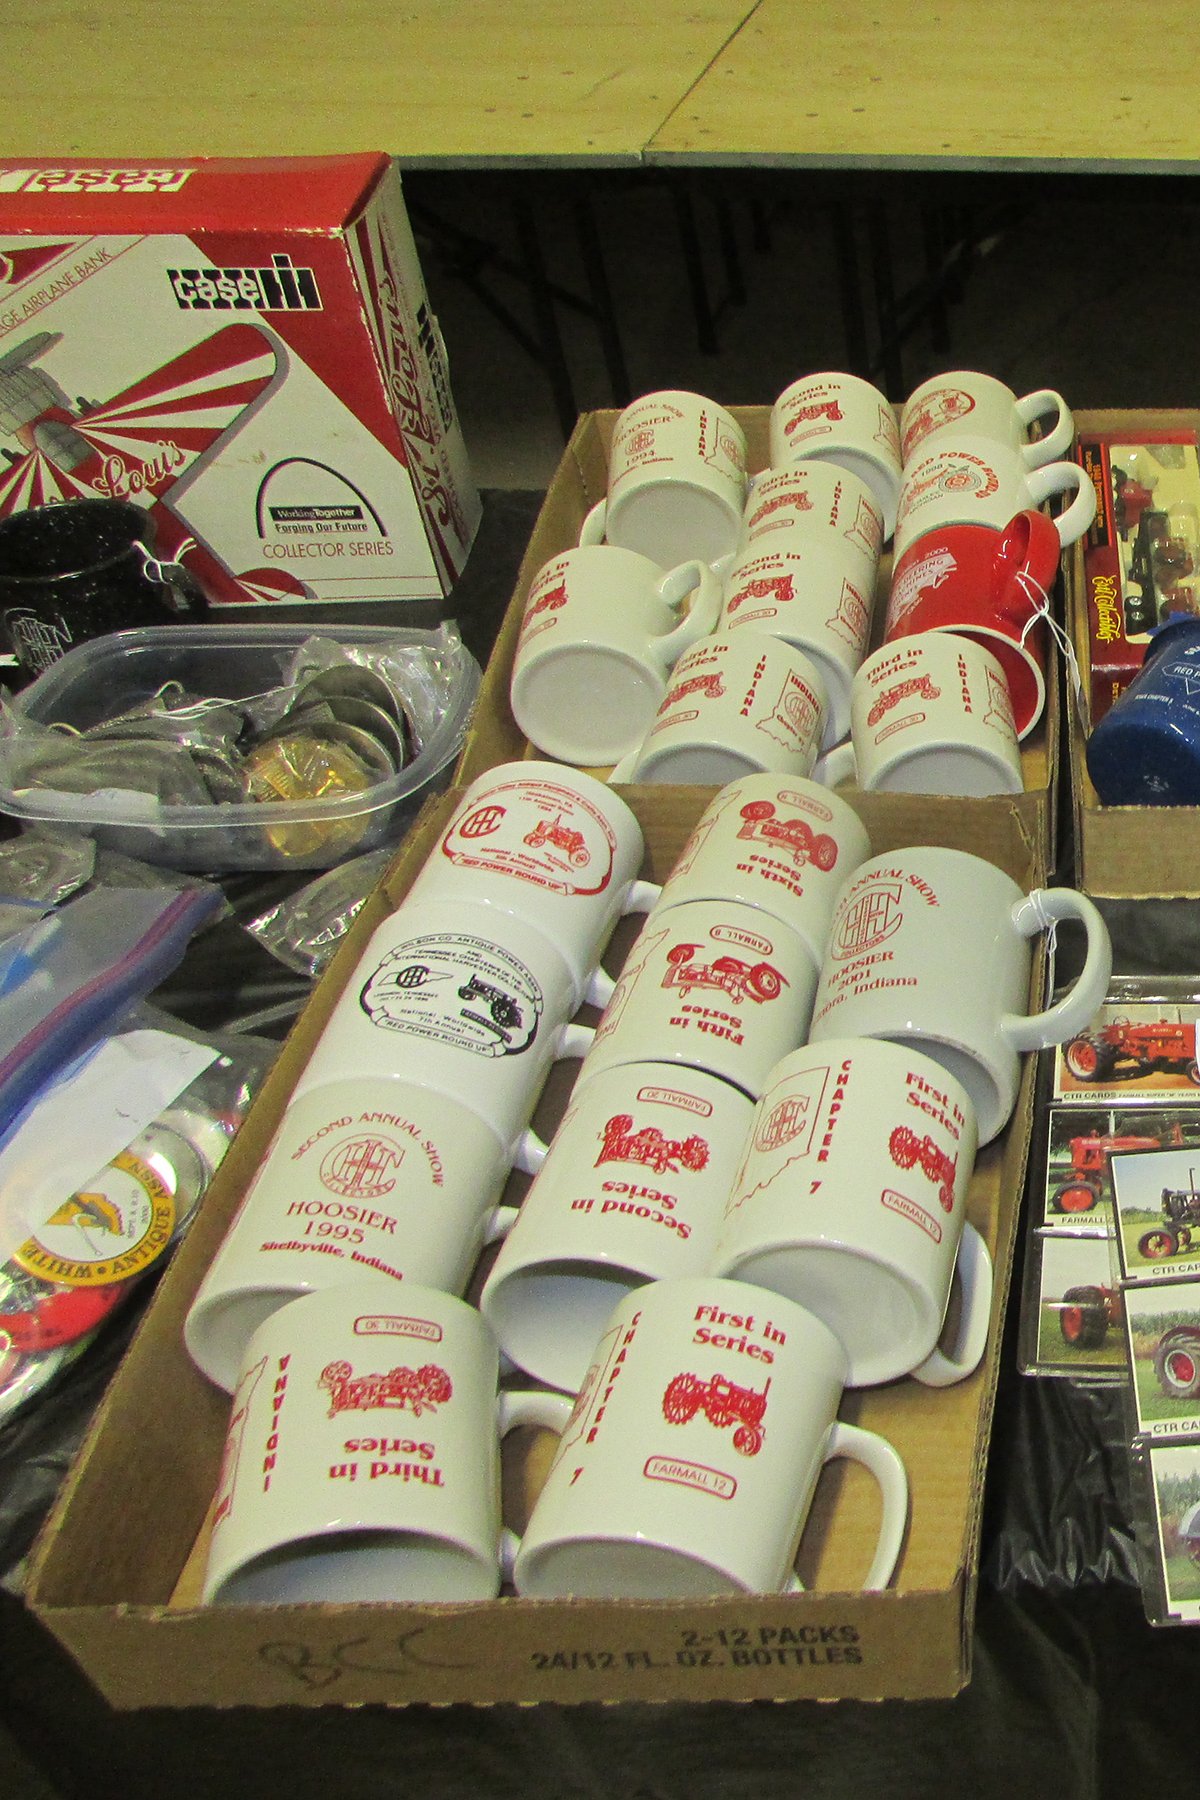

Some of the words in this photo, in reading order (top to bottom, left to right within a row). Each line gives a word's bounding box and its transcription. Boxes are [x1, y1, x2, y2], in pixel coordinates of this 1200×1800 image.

[22, 271, 78, 316] AIRPLANE
[76, 247, 115, 279] BANK
[698, 409, 708, 457] INDIANA
[92, 440, 187, 501] Louis
[939, 451, 986, 466] POWER
[828, 480, 843, 527] INDIANA
[315, 521, 334, 533] Our
[334, 521, 368, 533] Future
[262, 543, 347, 560] COLLECTOR
[349, 541, 394, 558] SERIES
[786, 551, 801, 560] in
[712, 644, 729, 653] in
[866, 653, 902, 681] Third
[907, 648, 924, 658] in
[1174, 666, 1194, 676] RED
[740, 654, 767, 717] INDIANA
[957, 653, 973, 714] INDIANA
[480, 861, 514, 874] POWER
[515, 870, 547, 886] ROUND
[736, 862, 755, 875] in
[749, 854, 802, 882] Series
[905, 873, 941, 908] SHOW
[415, 949, 457, 957] TENNESSEE
[457, 936, 496, 951] ANTIQUE
[728, 929, 770, 953] FARMALL
[453, 959, 497, 978] HARVESTER
[837, 968, 872, 993] 2001
[854, 976, 918, 997] Indiana
[435, 1020, 466, 1034] Annual
[669, 1016, 691, 1029] in
[681, 1004, 743, 1029] Series
[405, 1025, 441, 1038] POWER
[441, 1034, 474, 1049] ROUND
[696, 1018, 745, 1047] Fifth
[646, 1091, 660, 1100] 20
[662, 1092, 708, 1113] FARMALL
[905, 1071, 950, 1110] First
[952, 1103, 966, 1128] in
[1084, 1091, 1117, 1099] CARDS
[817, 1059, 853, 1163] CHAPTER
[906, 1091, 961, 1141] Series
[290, 1115, 353, 1161] SECOND
[359, 1111, 423, 1141] ANNUAL
[421, 1140, 445, 1188] SHOW
[601, 1180, 678, 1211] Series
[809, 1179, 822, 1195] 7
[286, 1200, 399, 1235] HOOSIER
[571, 1198, 596, 1214] in
[888, 1194, 928, 1226] FARMALL
[928, 1220, 939, 1235] 12
[601, 1198, 692, 1240] Second
[1061, 1216, 1105, 1225] FARMALL
[111, 1204, 172, 1275] ANTIQUE
[303, 1220, 366, 1245] 1995
[260, 1240, 346, 1258] Shelbyville,
[350, 1250, 404, 1282] Indiana
[1152, 1266, 1177, 1275] CTR
[364, 1320, 380, 1331] 30
[384, 1319, 436, 1338] FARMALL
[694, 1304, 756, 1333] First
[763, 1321, 788, 1346] in
[691, 1327, 775, 1366] Series
[585, 1310, 643, 1445] CHAPTER
[263, 1353, 292, 1493] INDIANA
[1153, 1421, 1178, 1434] CTR
[344, 1438, 436, 1462] Series
[328, 1463, 359, 1482] in
[369, 1461, 446, 1488] Third
[652, 1461, 711, 1486] FARMALL
[712, 1477, 728, 1492] 12
[681, 1628, 752, 1649] 2-12
[759, 1625, 861, 1647] PACKS
[531, 1651, 617, 1673] 24/12
[731, 1645, 863, 1668] BOTTLES
